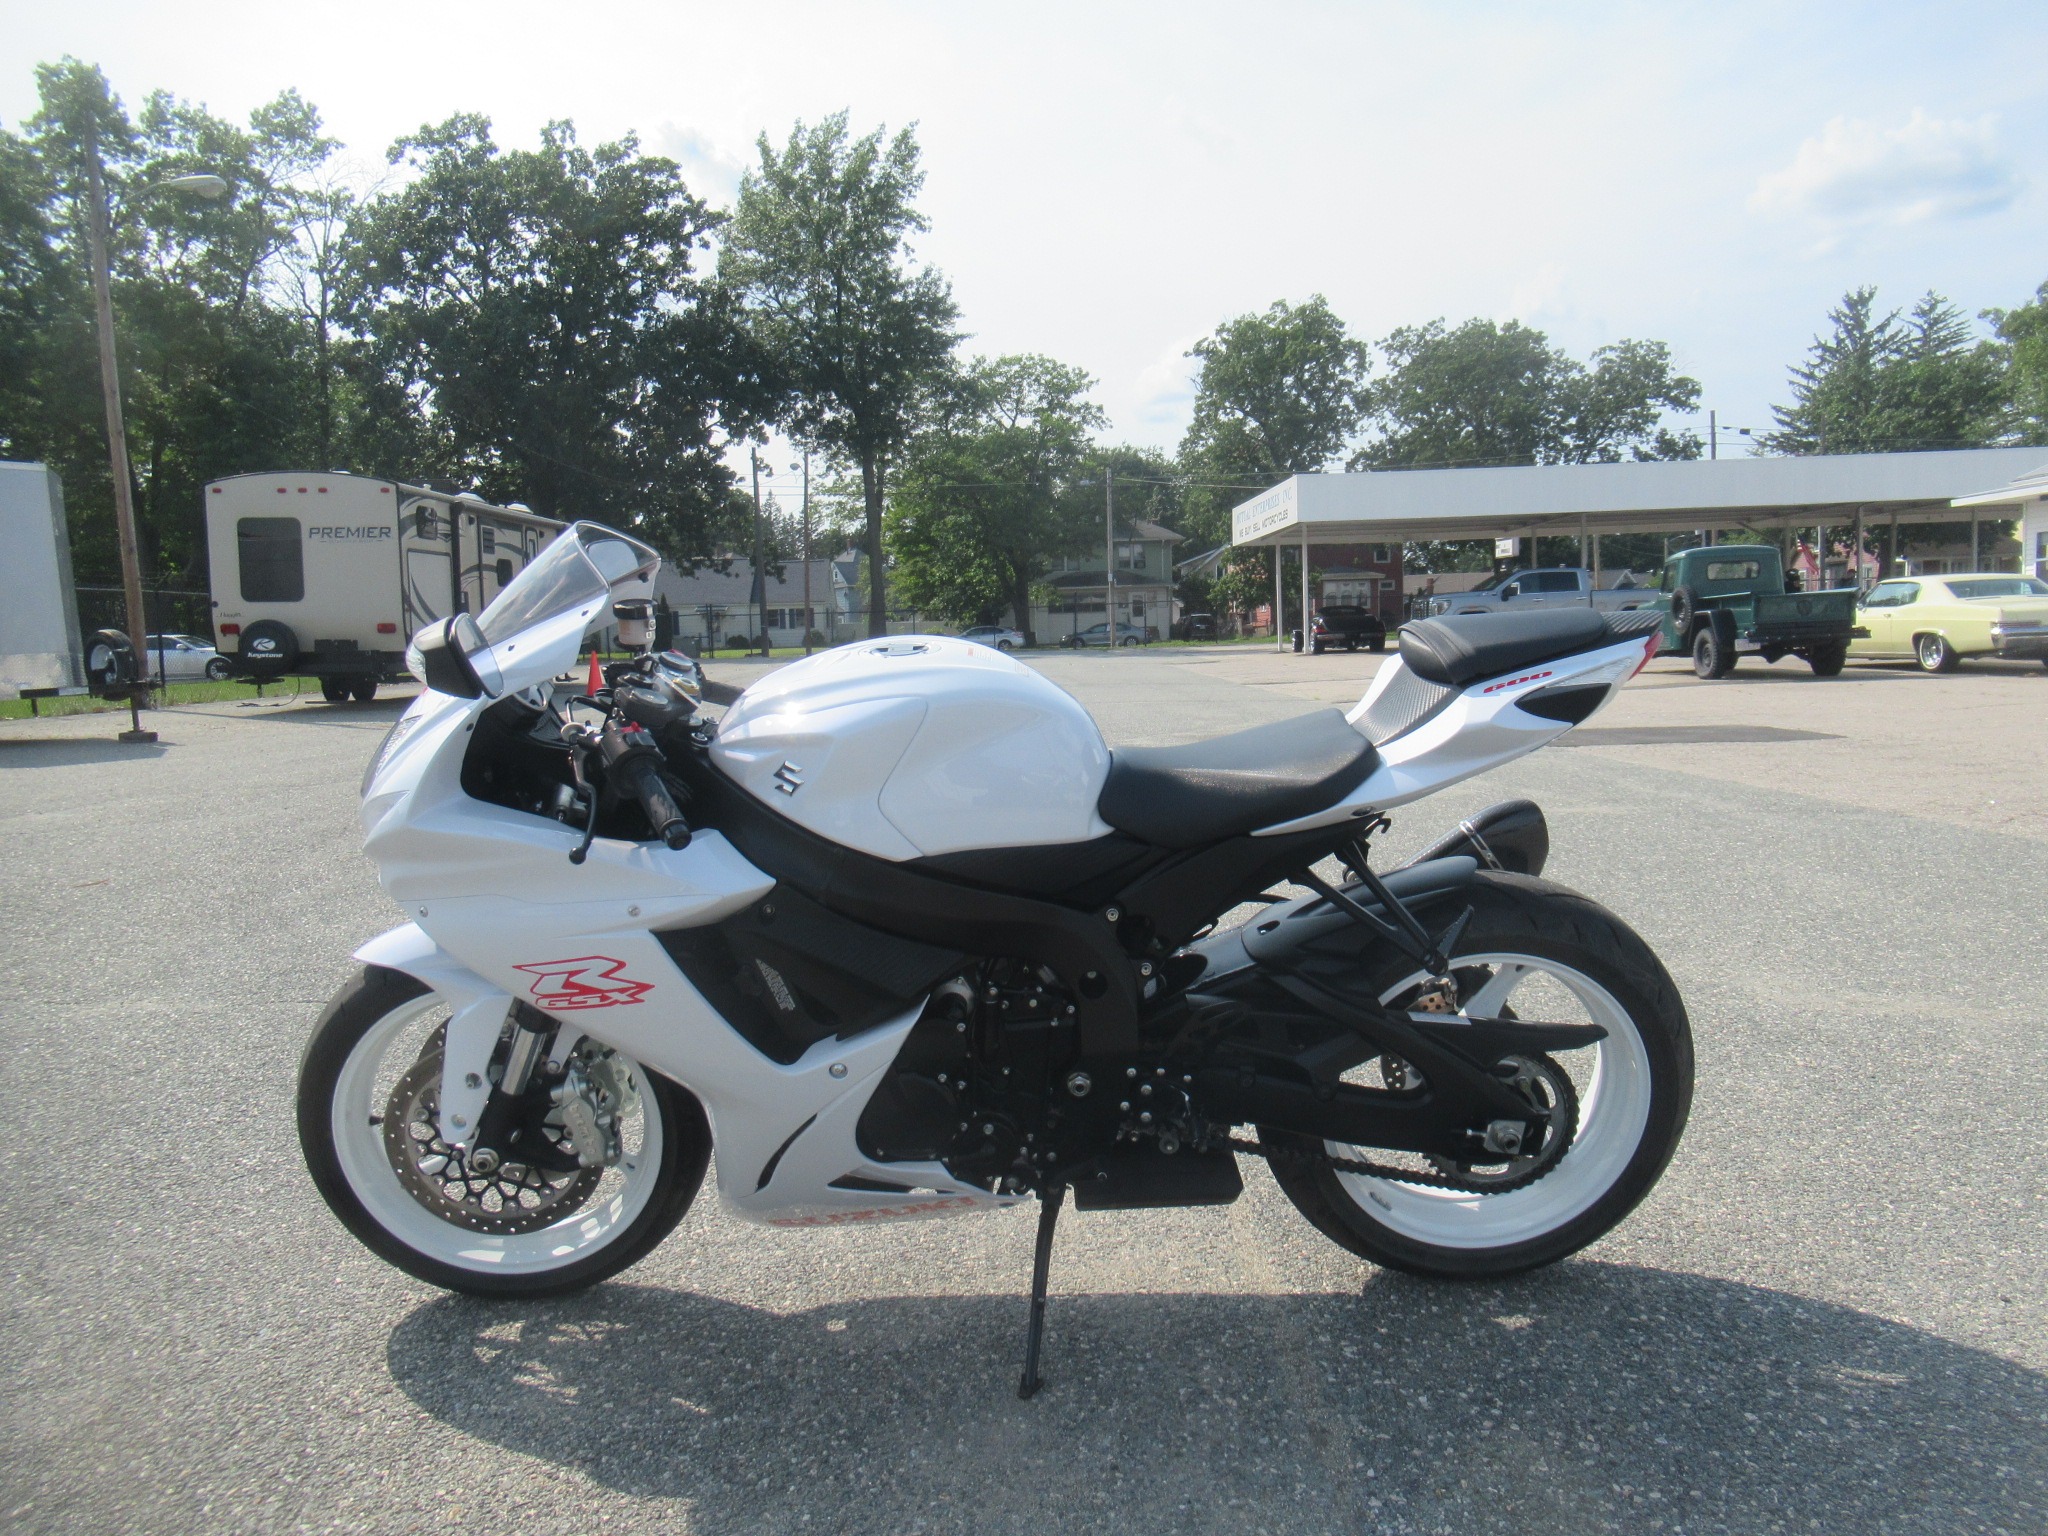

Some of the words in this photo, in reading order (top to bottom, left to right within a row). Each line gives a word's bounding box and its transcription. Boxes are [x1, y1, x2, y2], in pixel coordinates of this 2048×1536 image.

[1261, 508, 1289, 529] MOTORCYCLES
[308, 525, 392, 540] PREMIER
[247, 651, 284, 659] Keystone
[1483, 670, 1553, 694] 600
